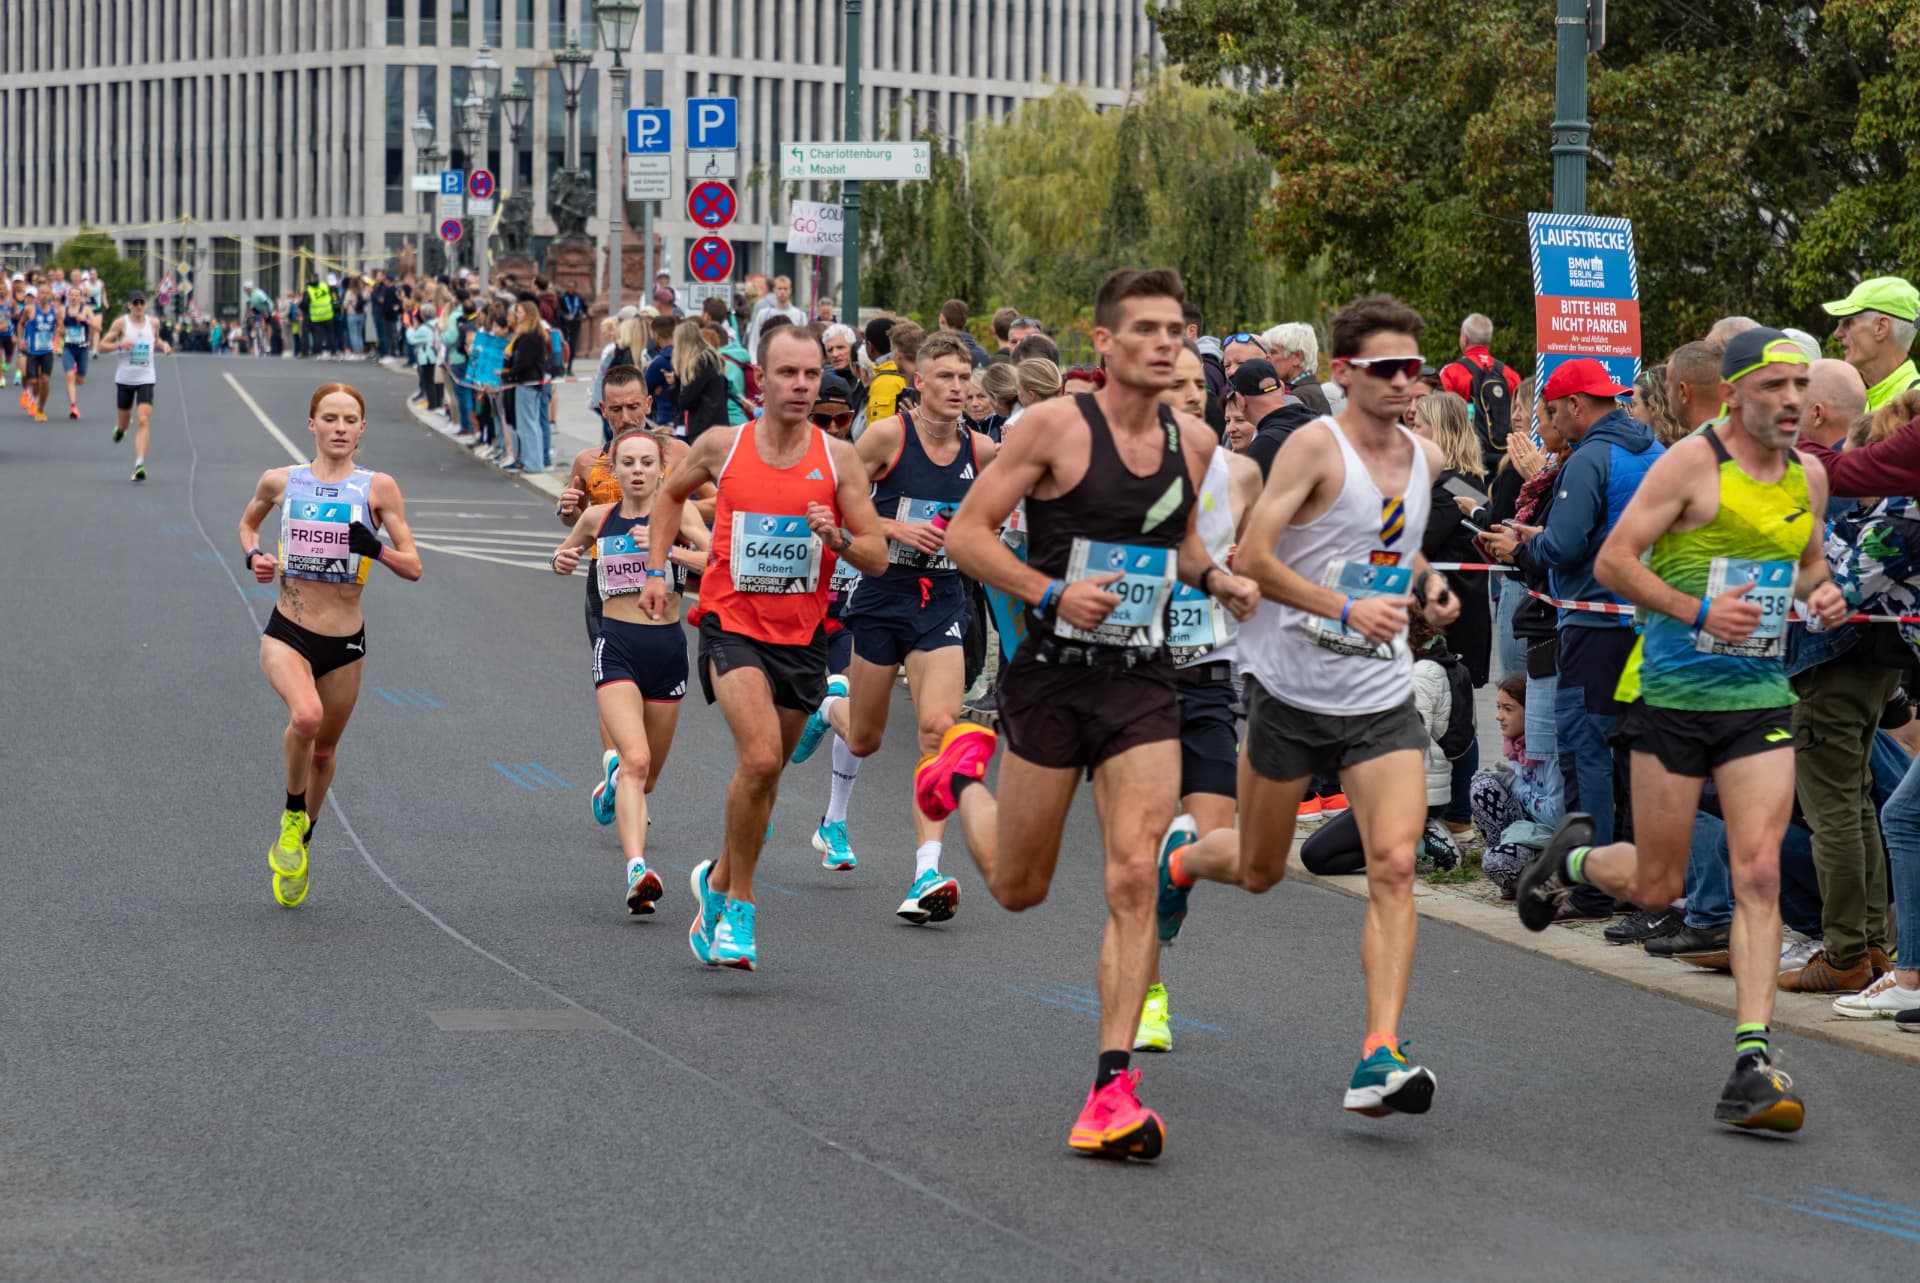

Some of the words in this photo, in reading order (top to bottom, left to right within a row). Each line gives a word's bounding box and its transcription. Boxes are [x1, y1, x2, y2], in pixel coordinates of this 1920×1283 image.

[698, 104, 726, 142] P
[637, 114, 661, 148] P
[810, 147, 892, 161] Charlottenburg
[810, 163, 846, 174] Moabit
[793, 217, 818, 233] GO
[1539, 227, 1626, 250] LAUFSTRECKE
[1568, 256, 1591, 270] BMW
[1569, 269, 1592, 279] BERLIN
[1569, 278, 1605, 289] MARATHON
[1561, 299, 1591, 316] BITTE
[1592, 301, 1617, 317] HIER
[1551, 316, 1585, 333] NICHT
[1586, 318, 1628, 334] PARKEN
[1580, 335, 1591, 343] und
[1547, 343, 1569, 351] während
[1577, 344, 1595, 353] Rennen
[1595, 345, 1612, 353] NICHT
[291, 529, 349, 544] FRISBIE
[745, 541, 808, 560] 64460
[289, 555, 327, 565] IMPOSSIBLE
[294, 563, 325, 572] NOTHING
[758, 563, 793, 574] Robert
[741, 576, 787, 586] IMPOSSIBLE
[748, 584, 785, 594] NOTHING
[1110, 608, 1132, 621] ack
